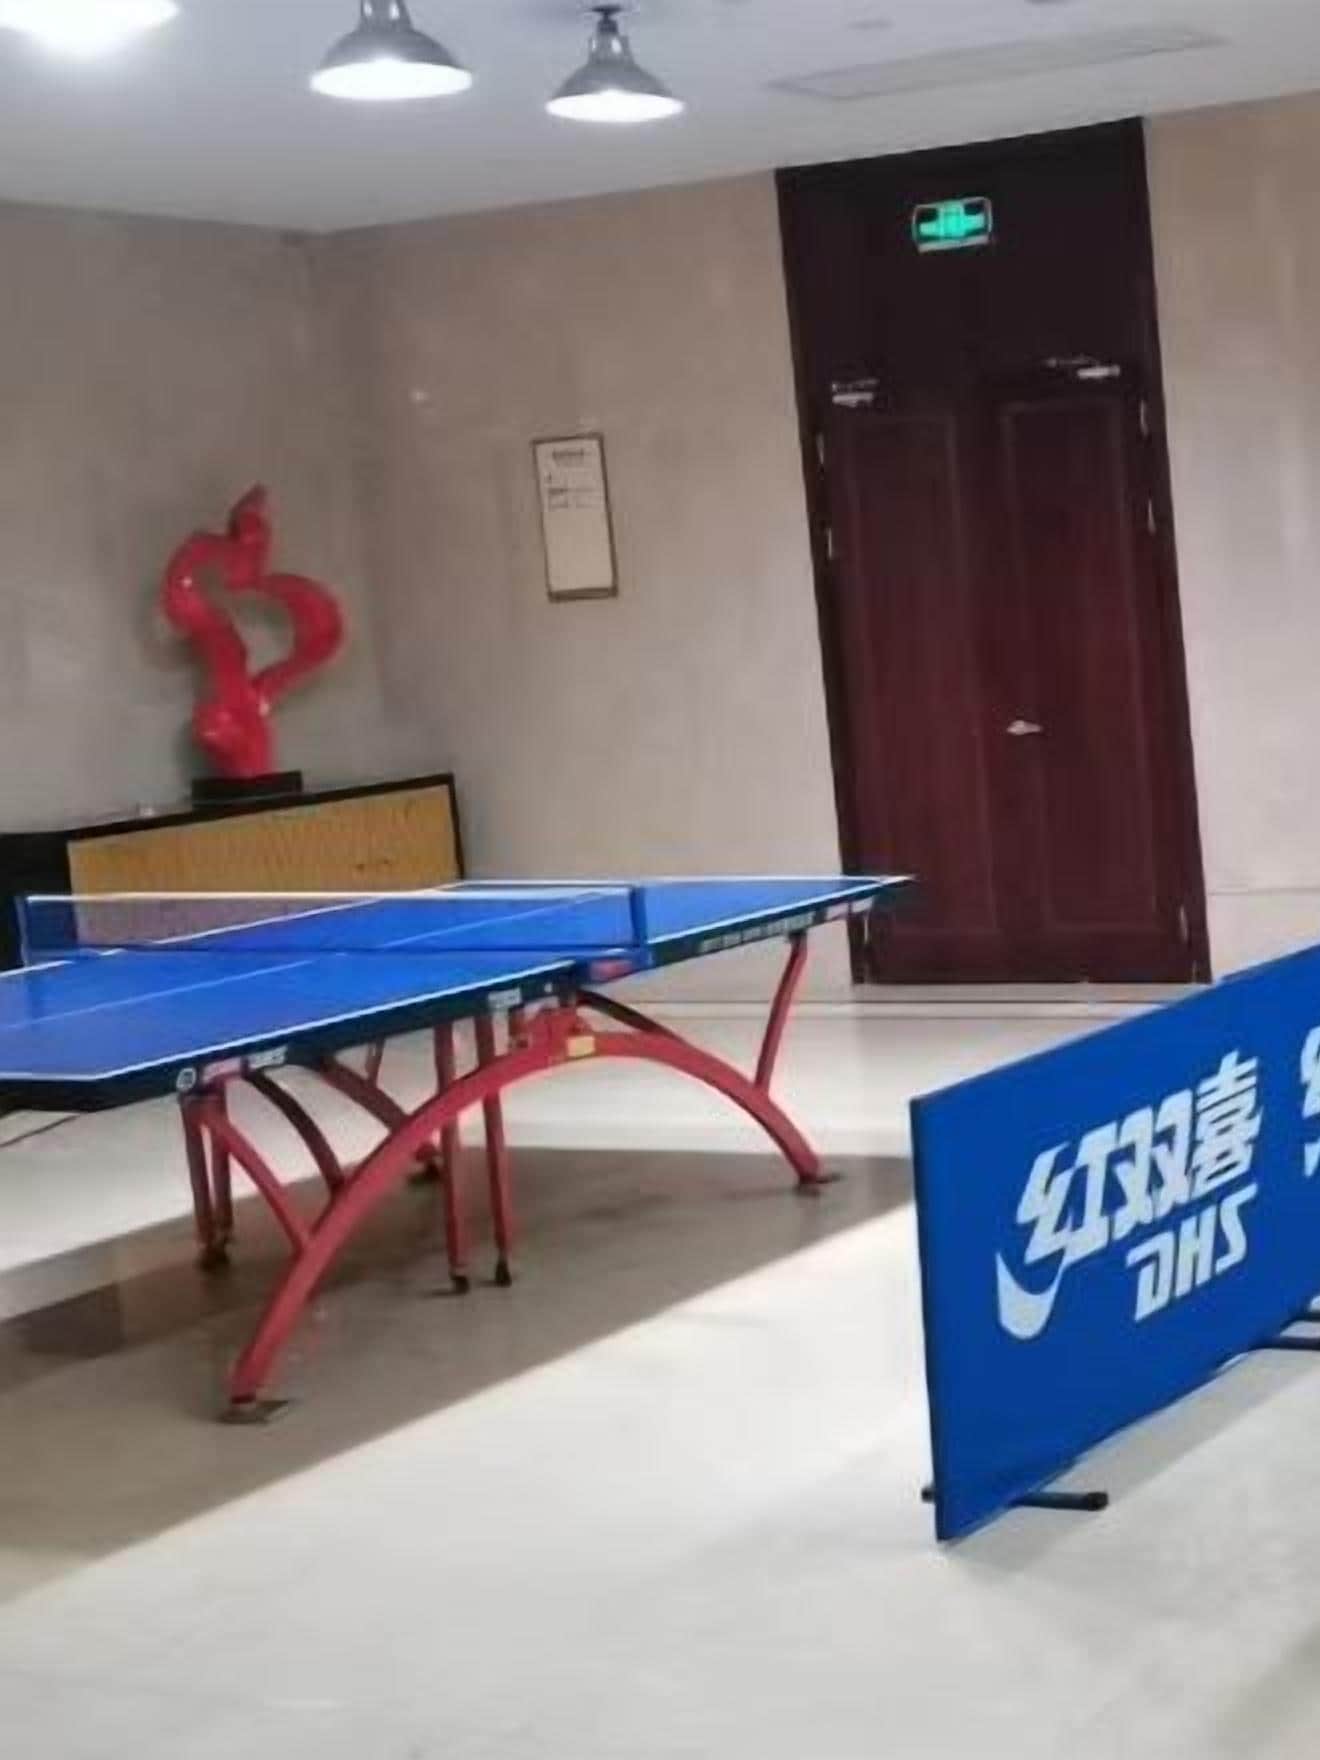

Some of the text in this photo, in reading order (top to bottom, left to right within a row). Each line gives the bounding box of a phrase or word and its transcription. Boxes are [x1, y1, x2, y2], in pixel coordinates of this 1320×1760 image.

[1014, 1048, 1263, 1274] 红双喜
[1126, 1183, 1258, 1322] DHS
